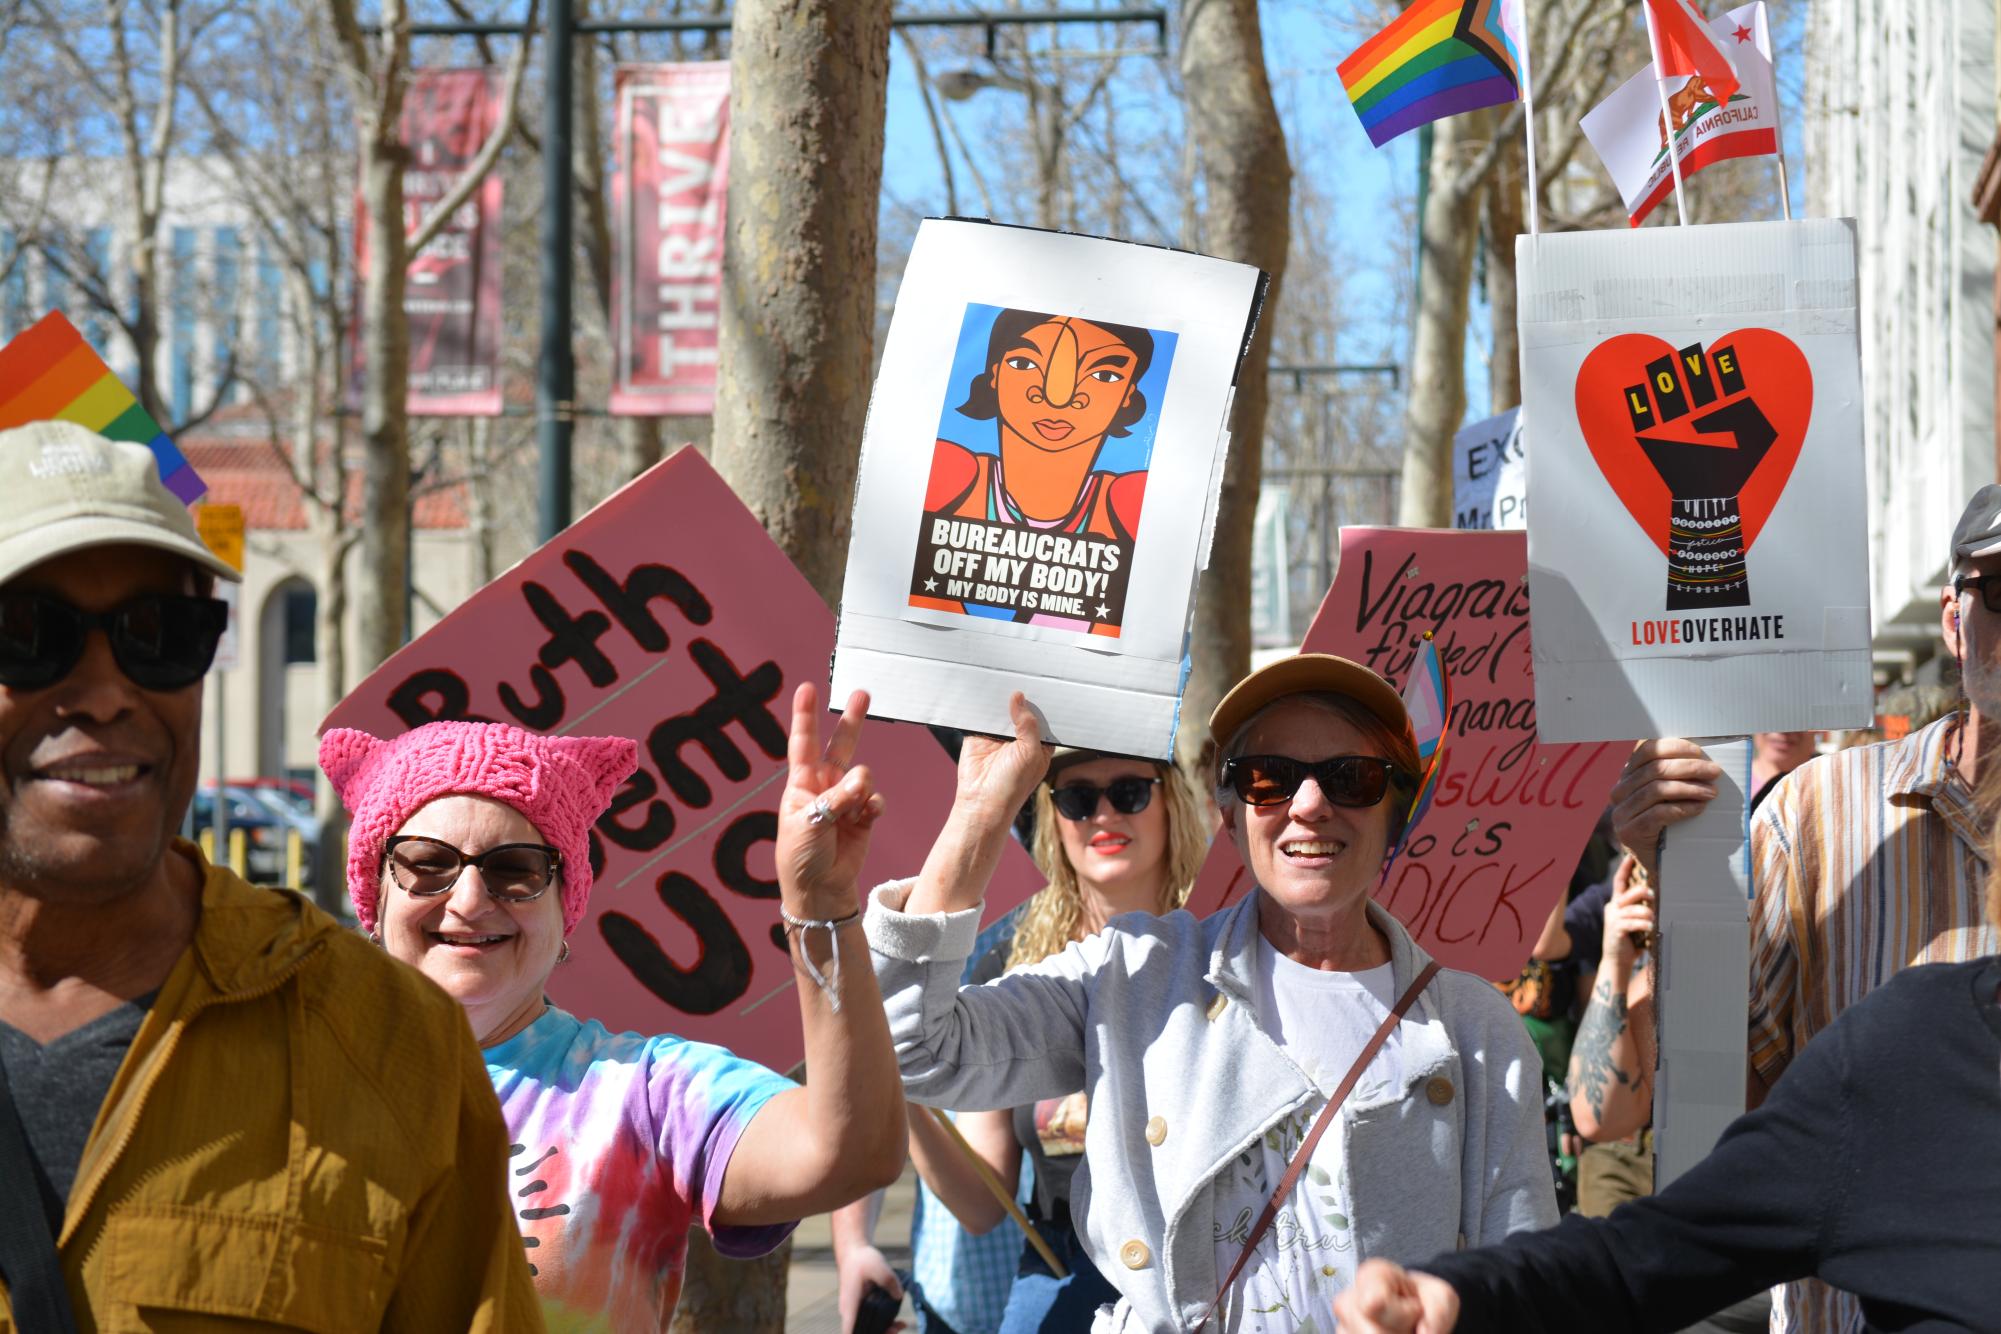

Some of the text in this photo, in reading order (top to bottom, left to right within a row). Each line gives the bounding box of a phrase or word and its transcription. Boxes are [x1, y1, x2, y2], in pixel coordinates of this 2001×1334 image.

[658, 103, 720, 379] THRIVE
[1630, 354, 1734, 414] LOVE
[1684, 498, 1727, 518] UNITY
[931, 518, 1121, 572] BUREAUCRATS
[933, 548, 1109, 599] OFF MY BODY!
[946, 579, 1086, 616] MY BODY IS MINE.
[589, 637, 790, 884] ent
[1452, 818, 1512, 856] is
[1387, 857, 1555, 945] DICK
